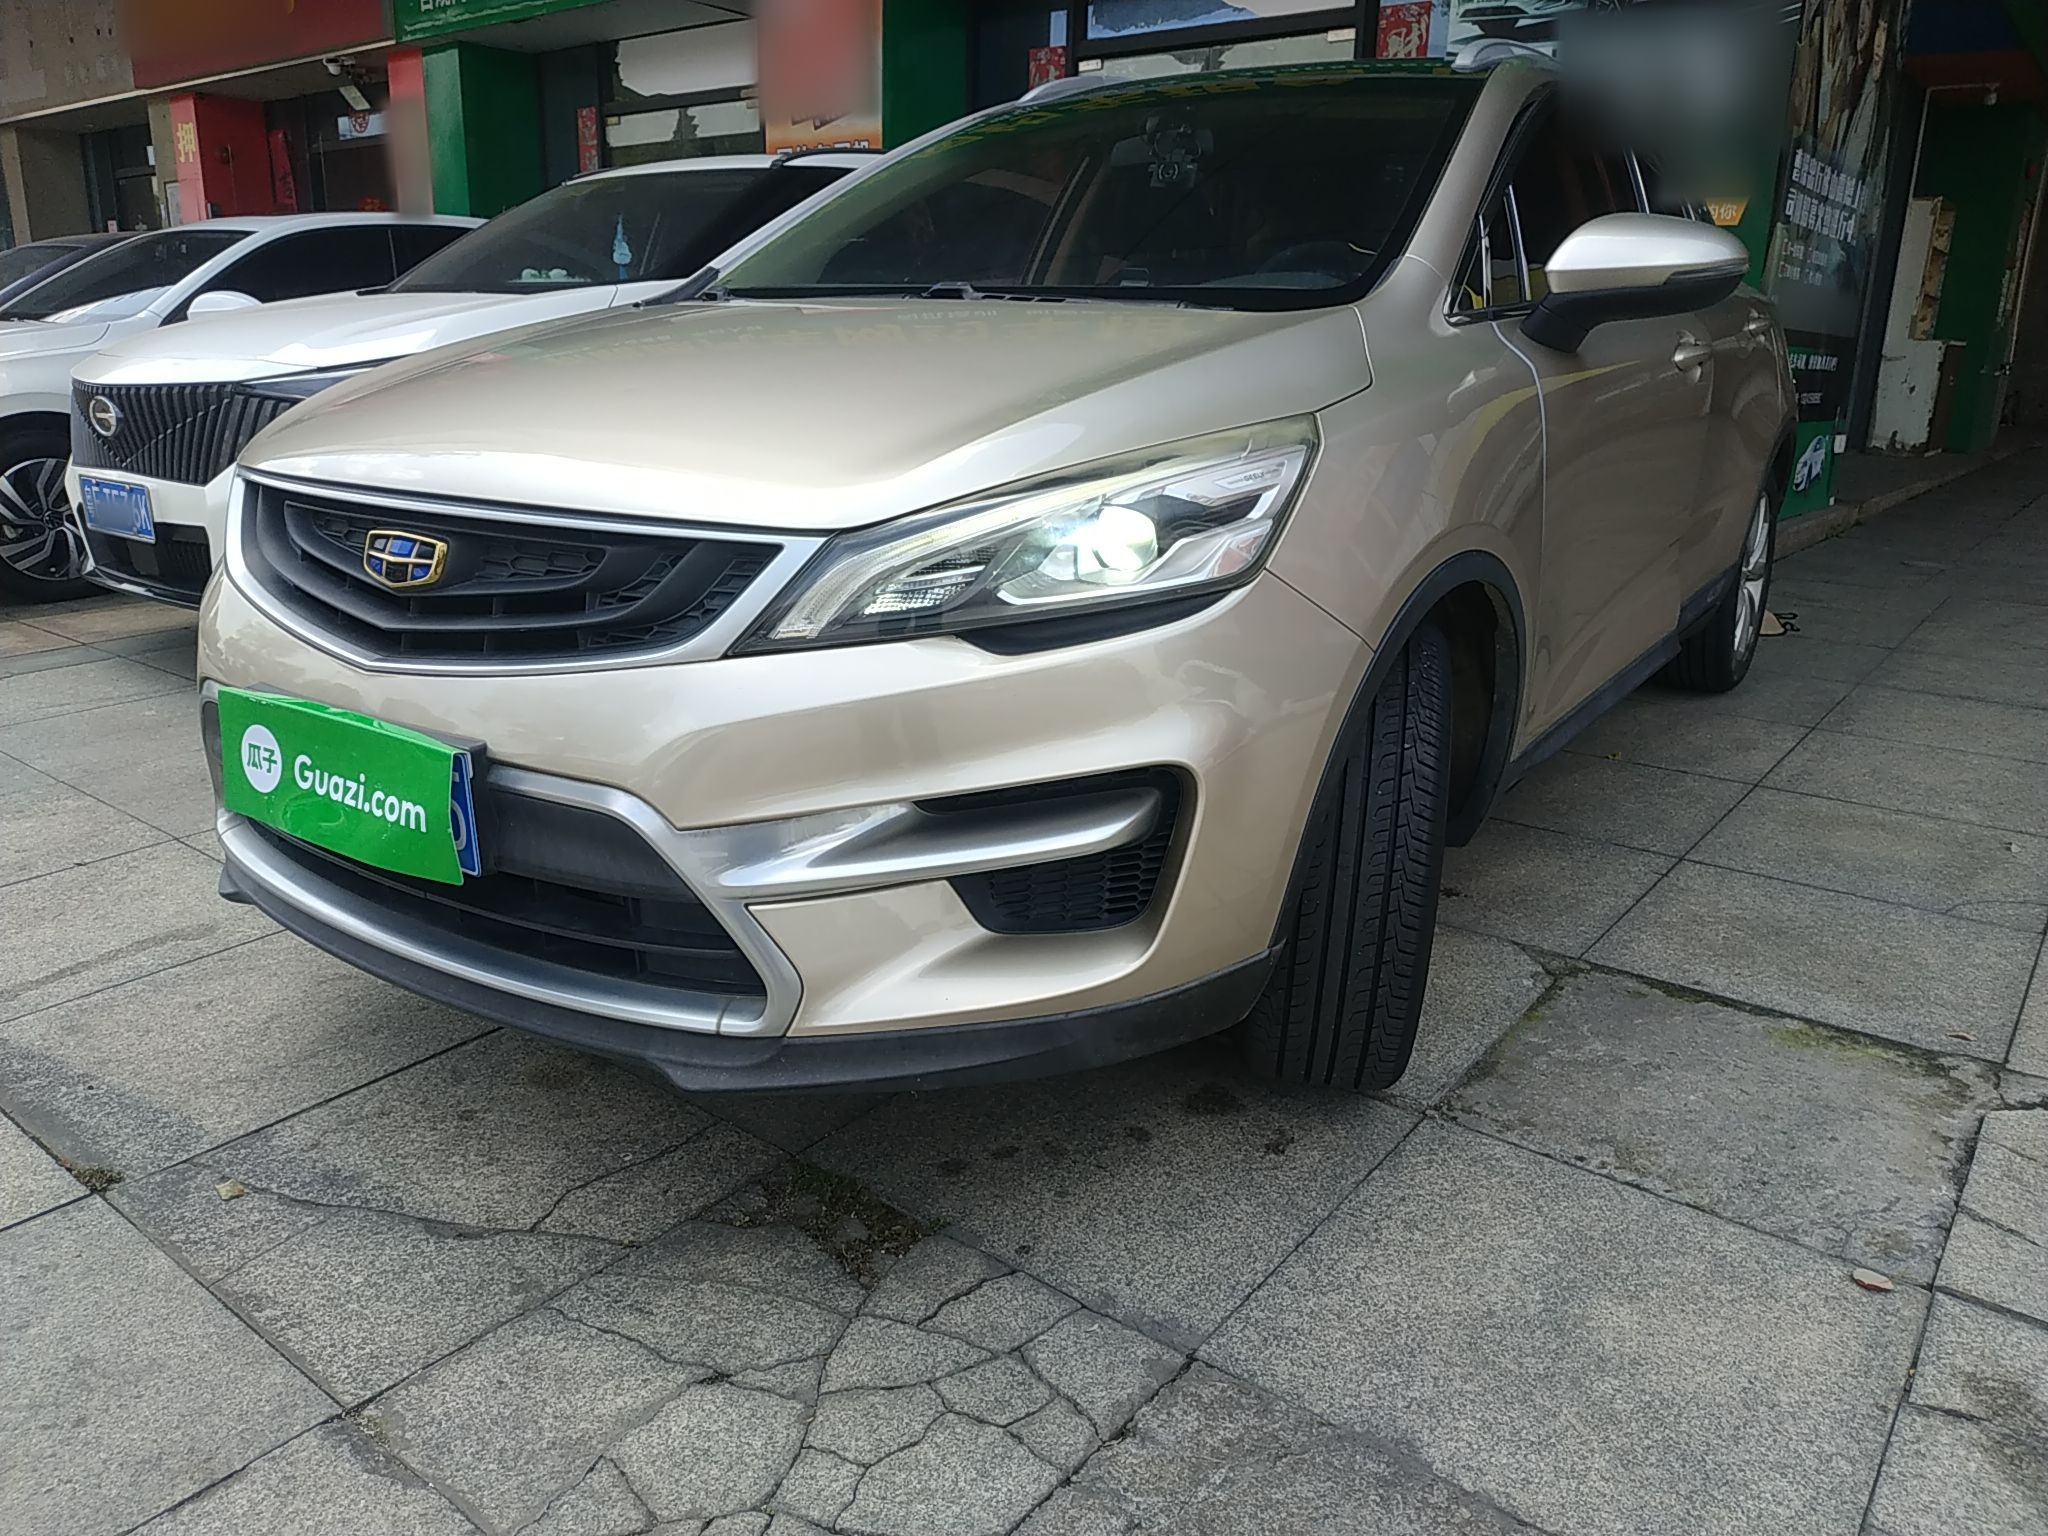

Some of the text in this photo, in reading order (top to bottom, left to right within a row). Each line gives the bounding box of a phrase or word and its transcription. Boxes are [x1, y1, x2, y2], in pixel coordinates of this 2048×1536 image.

[176, 122, 196, 163] 押
[1243, 472, 1265, 482] GEELY
[247, 742, 278, 774] 瓜子
[294, 754, 427, 833] Guazi.com
